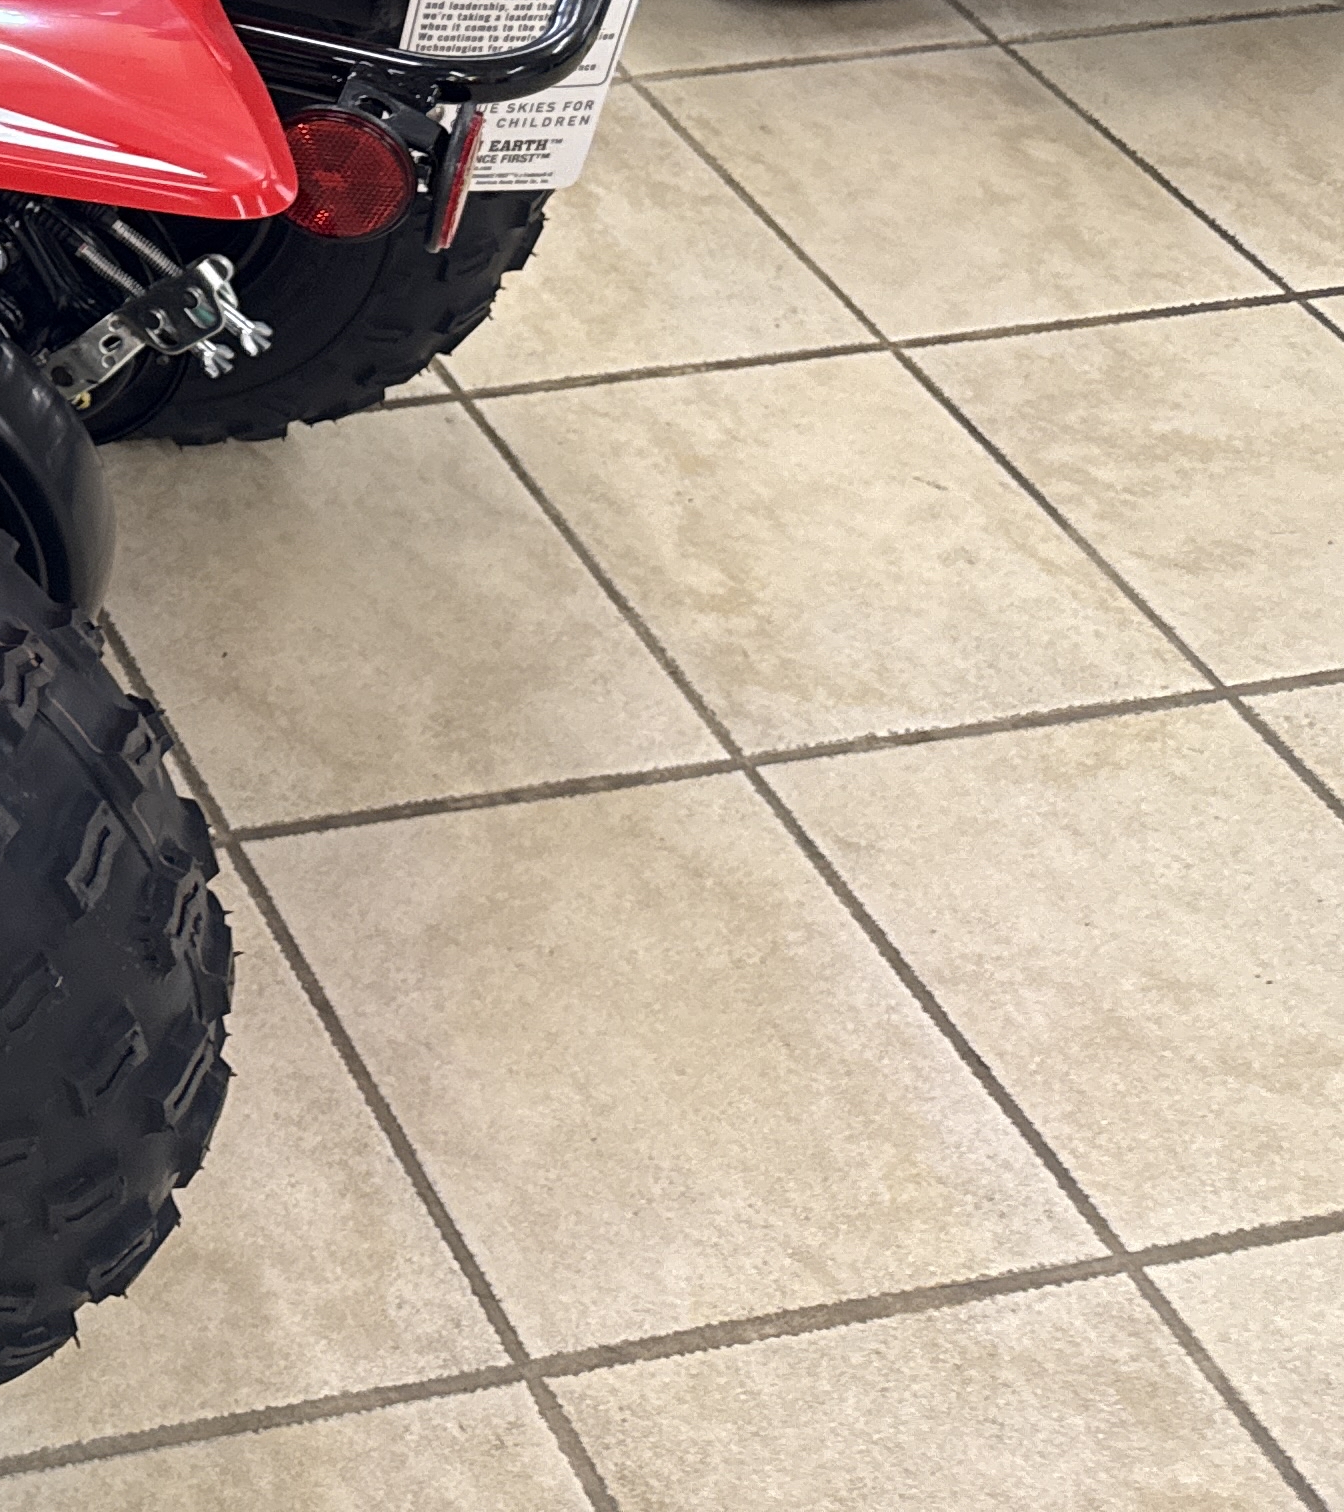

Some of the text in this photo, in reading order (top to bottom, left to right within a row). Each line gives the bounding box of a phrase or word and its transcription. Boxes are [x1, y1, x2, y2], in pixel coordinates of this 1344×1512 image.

[425, 1, 445, 9] and
[513, 2, 533, 11] and
[457, 13, 492, 23] taking
[420, 22, 448, 31] when
[452, 23, 461, 32] it
[503, 24, 514, 32] to
[518, 24, 535, 32] the
[418, 32, 433, 41] We
[437, 34, 484, 42] continue
[488, 34, 499, 42] to
[416, 44, 483, 54] technologies
[488, 44, 503, 52] for
[506, 102, 556, 113] SKIES
[563, 100, 595, 111] FOR
[496, 115, 591, 128] CHILDREN
